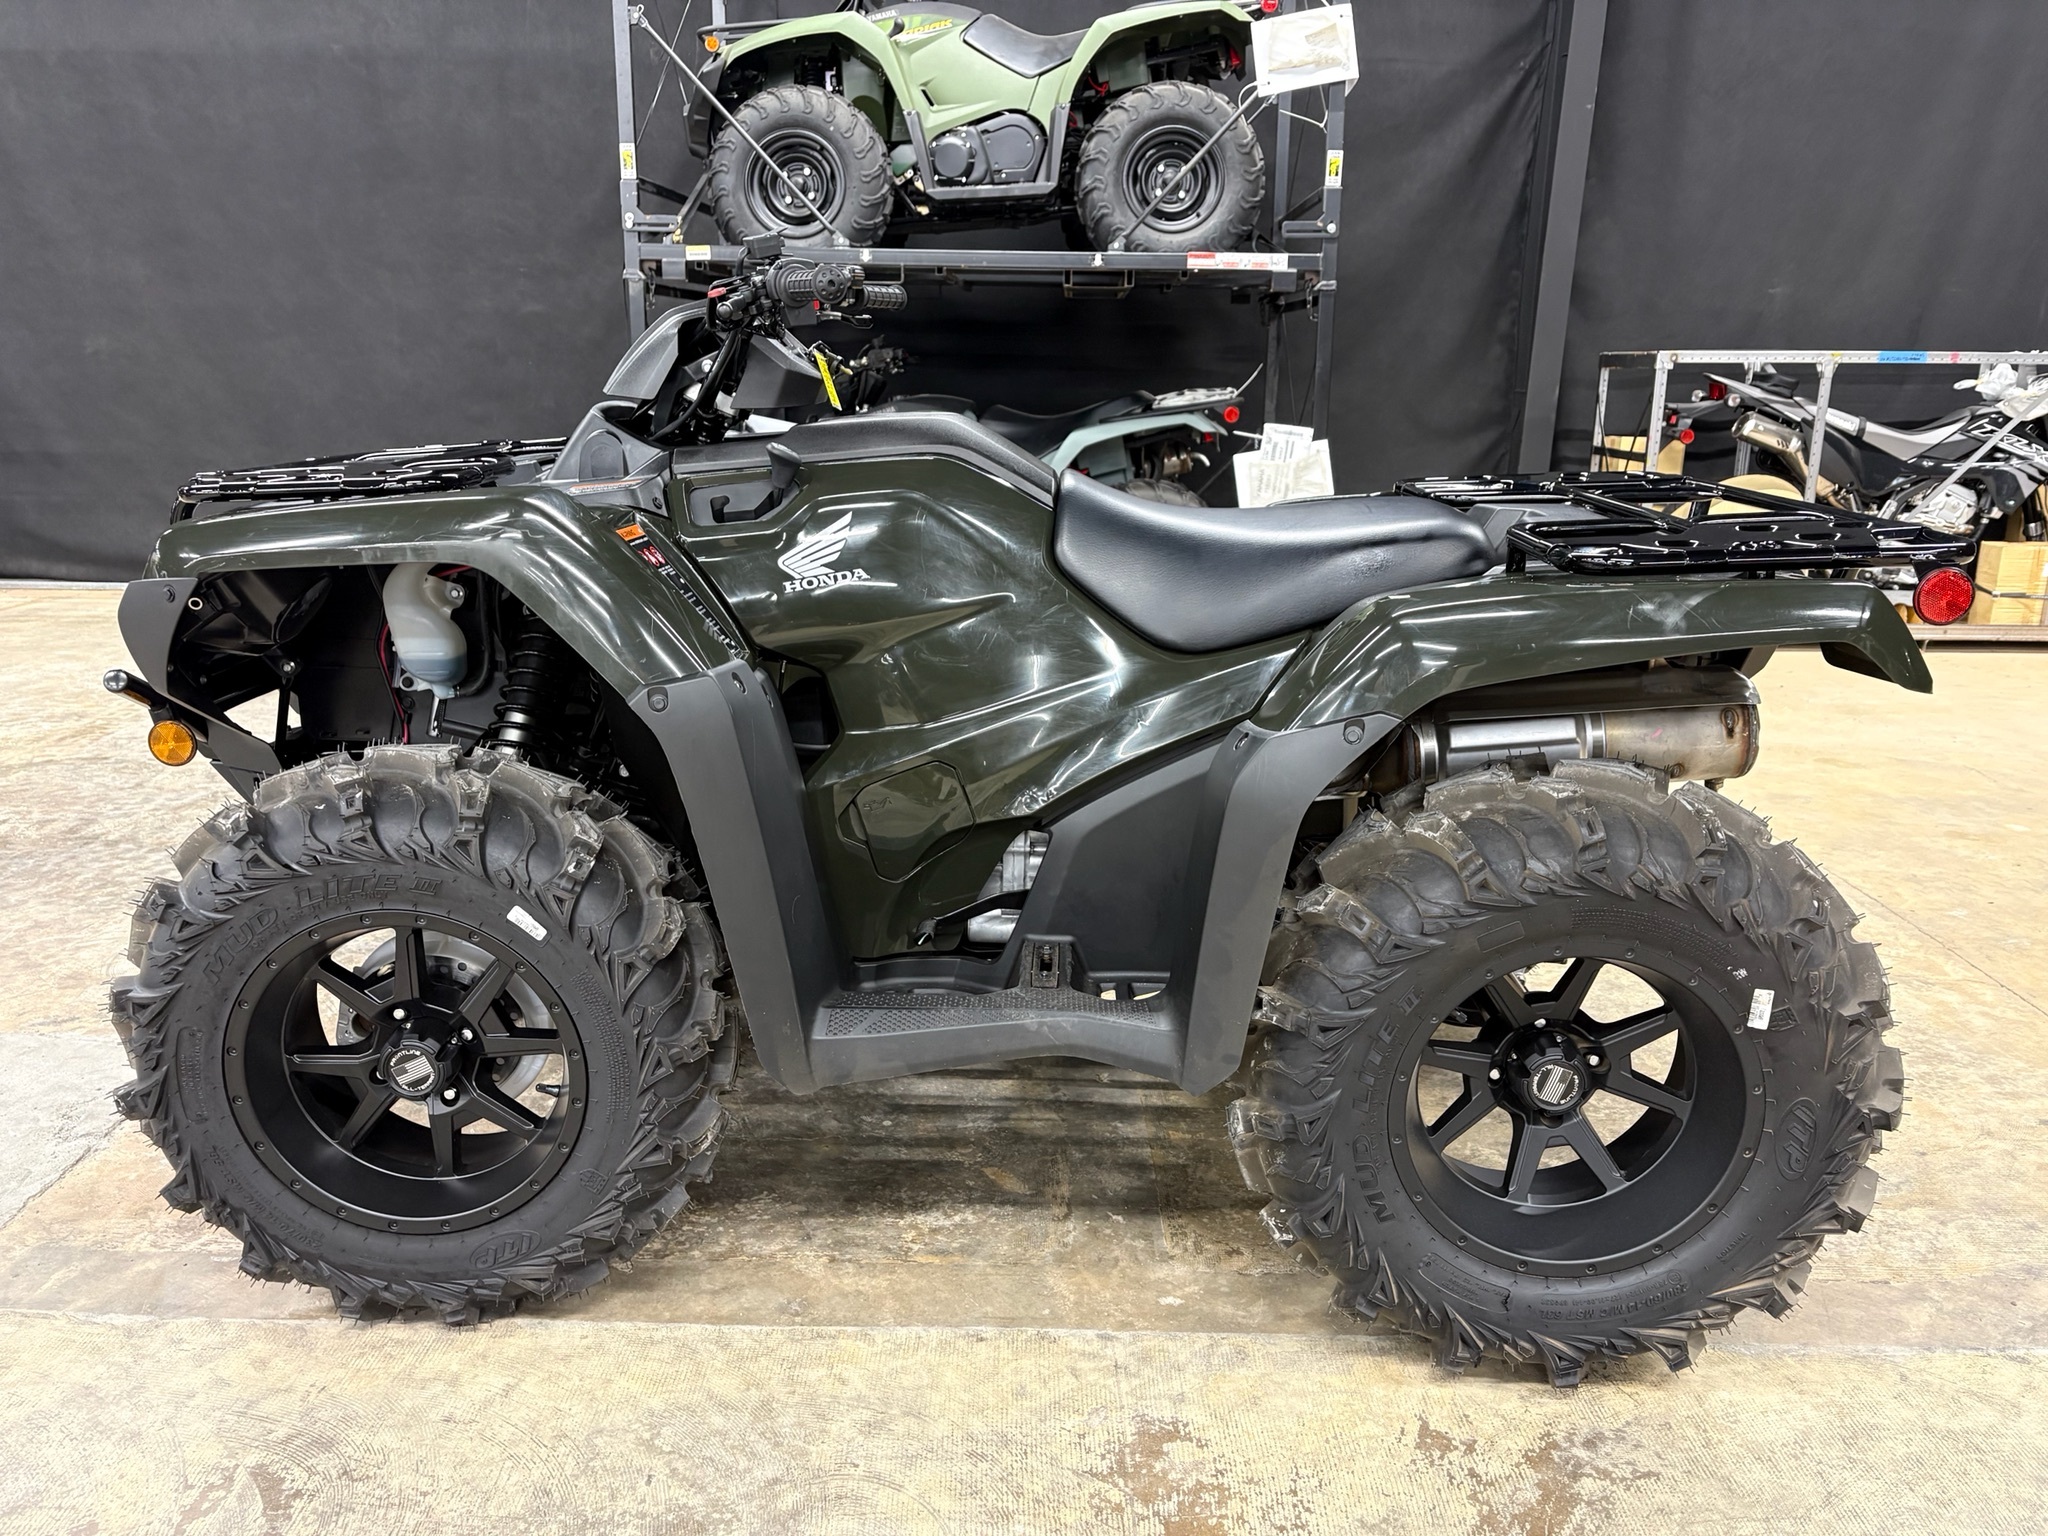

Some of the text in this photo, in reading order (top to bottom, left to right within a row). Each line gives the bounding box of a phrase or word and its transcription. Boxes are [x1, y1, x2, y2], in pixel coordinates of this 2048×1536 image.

[866, 10, 897, 21] YAMAHA
[782, 568, 871, 594] HONDA
[202, 907, 278, 985] MUD
[297, 873, 402, 909] LITE
[390, 1049, 421, 1067] FRONTLINE
[1352, 1015, 1400, 1114] LITE
[1783, 1105, 1815, 1173] ITP
[1352, 1134, 1396, 1224] MUD
[475, 1232, 533, 1270] ITP
